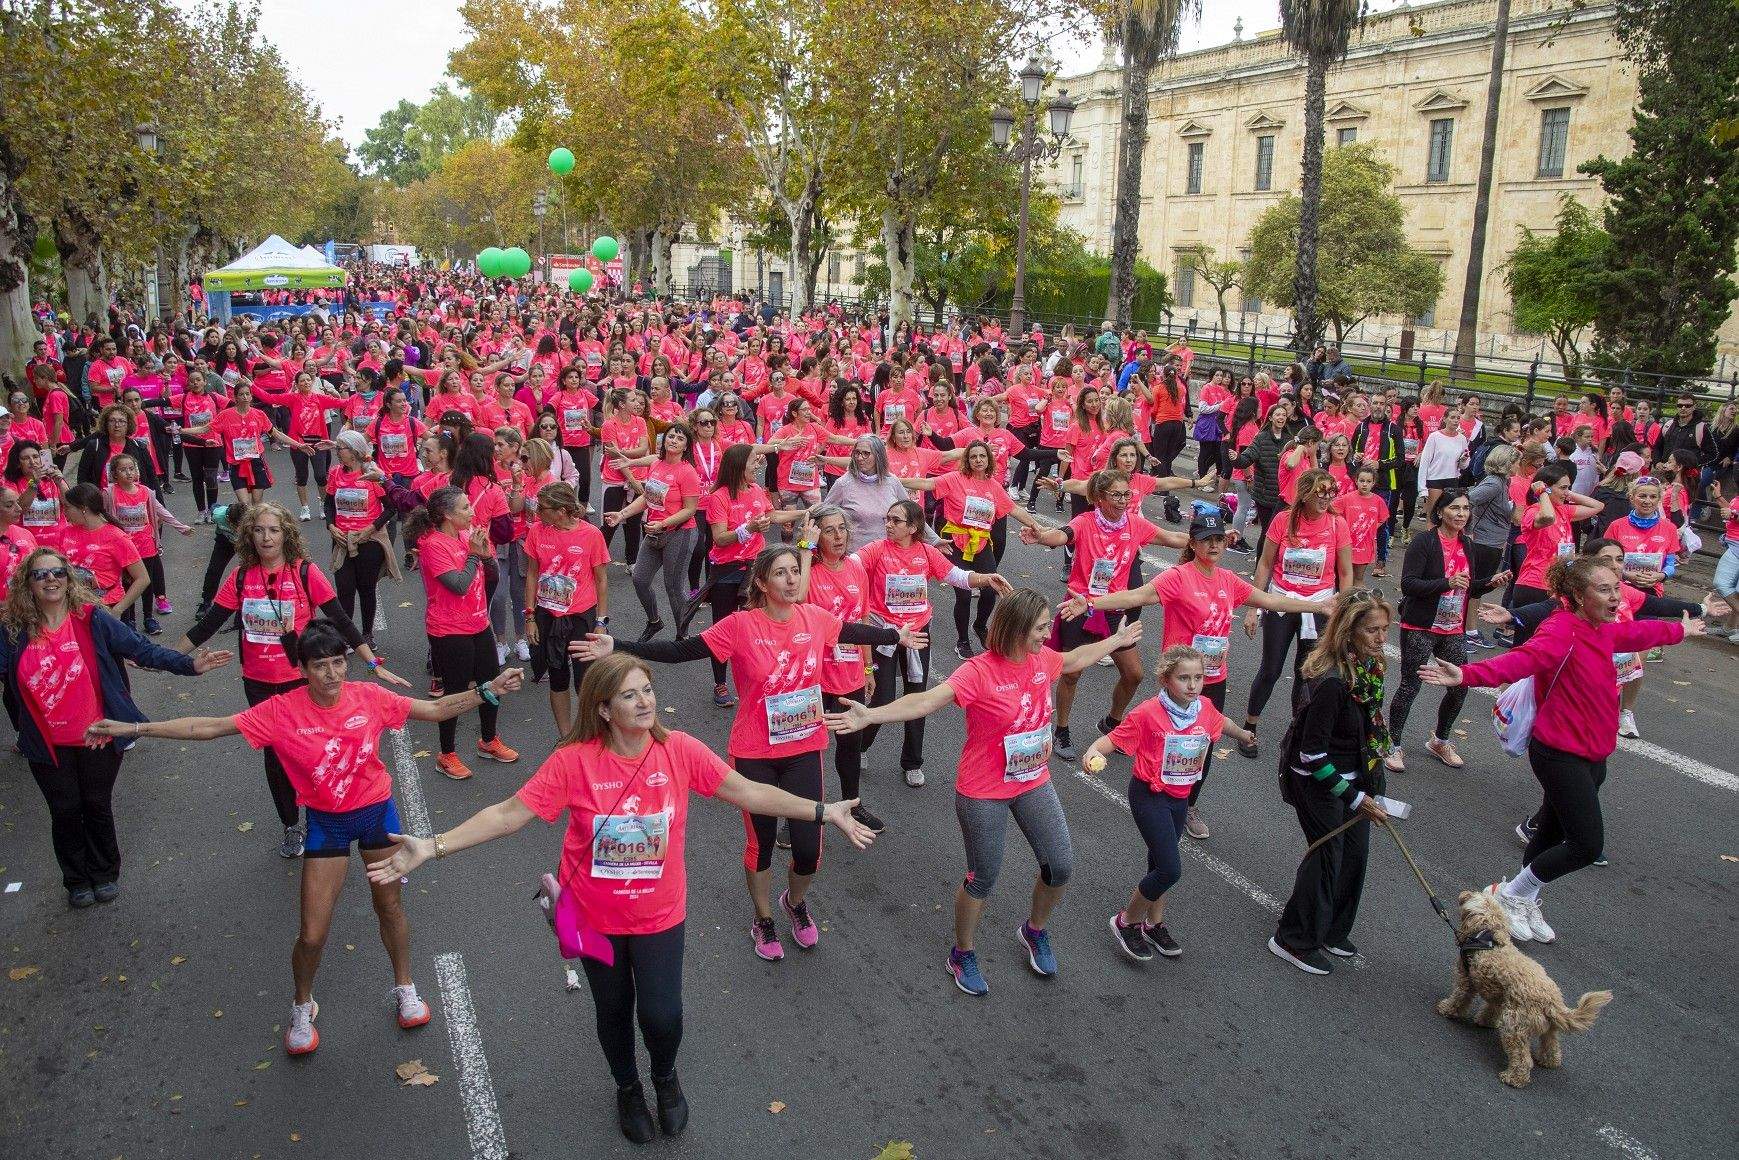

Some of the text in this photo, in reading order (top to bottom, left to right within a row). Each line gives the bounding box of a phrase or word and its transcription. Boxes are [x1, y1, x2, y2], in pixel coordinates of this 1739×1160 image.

[786, 711, 807, 724] 016
[592, 781, 623, 791] OYSHO
[617, 842, 646, 854] 016
